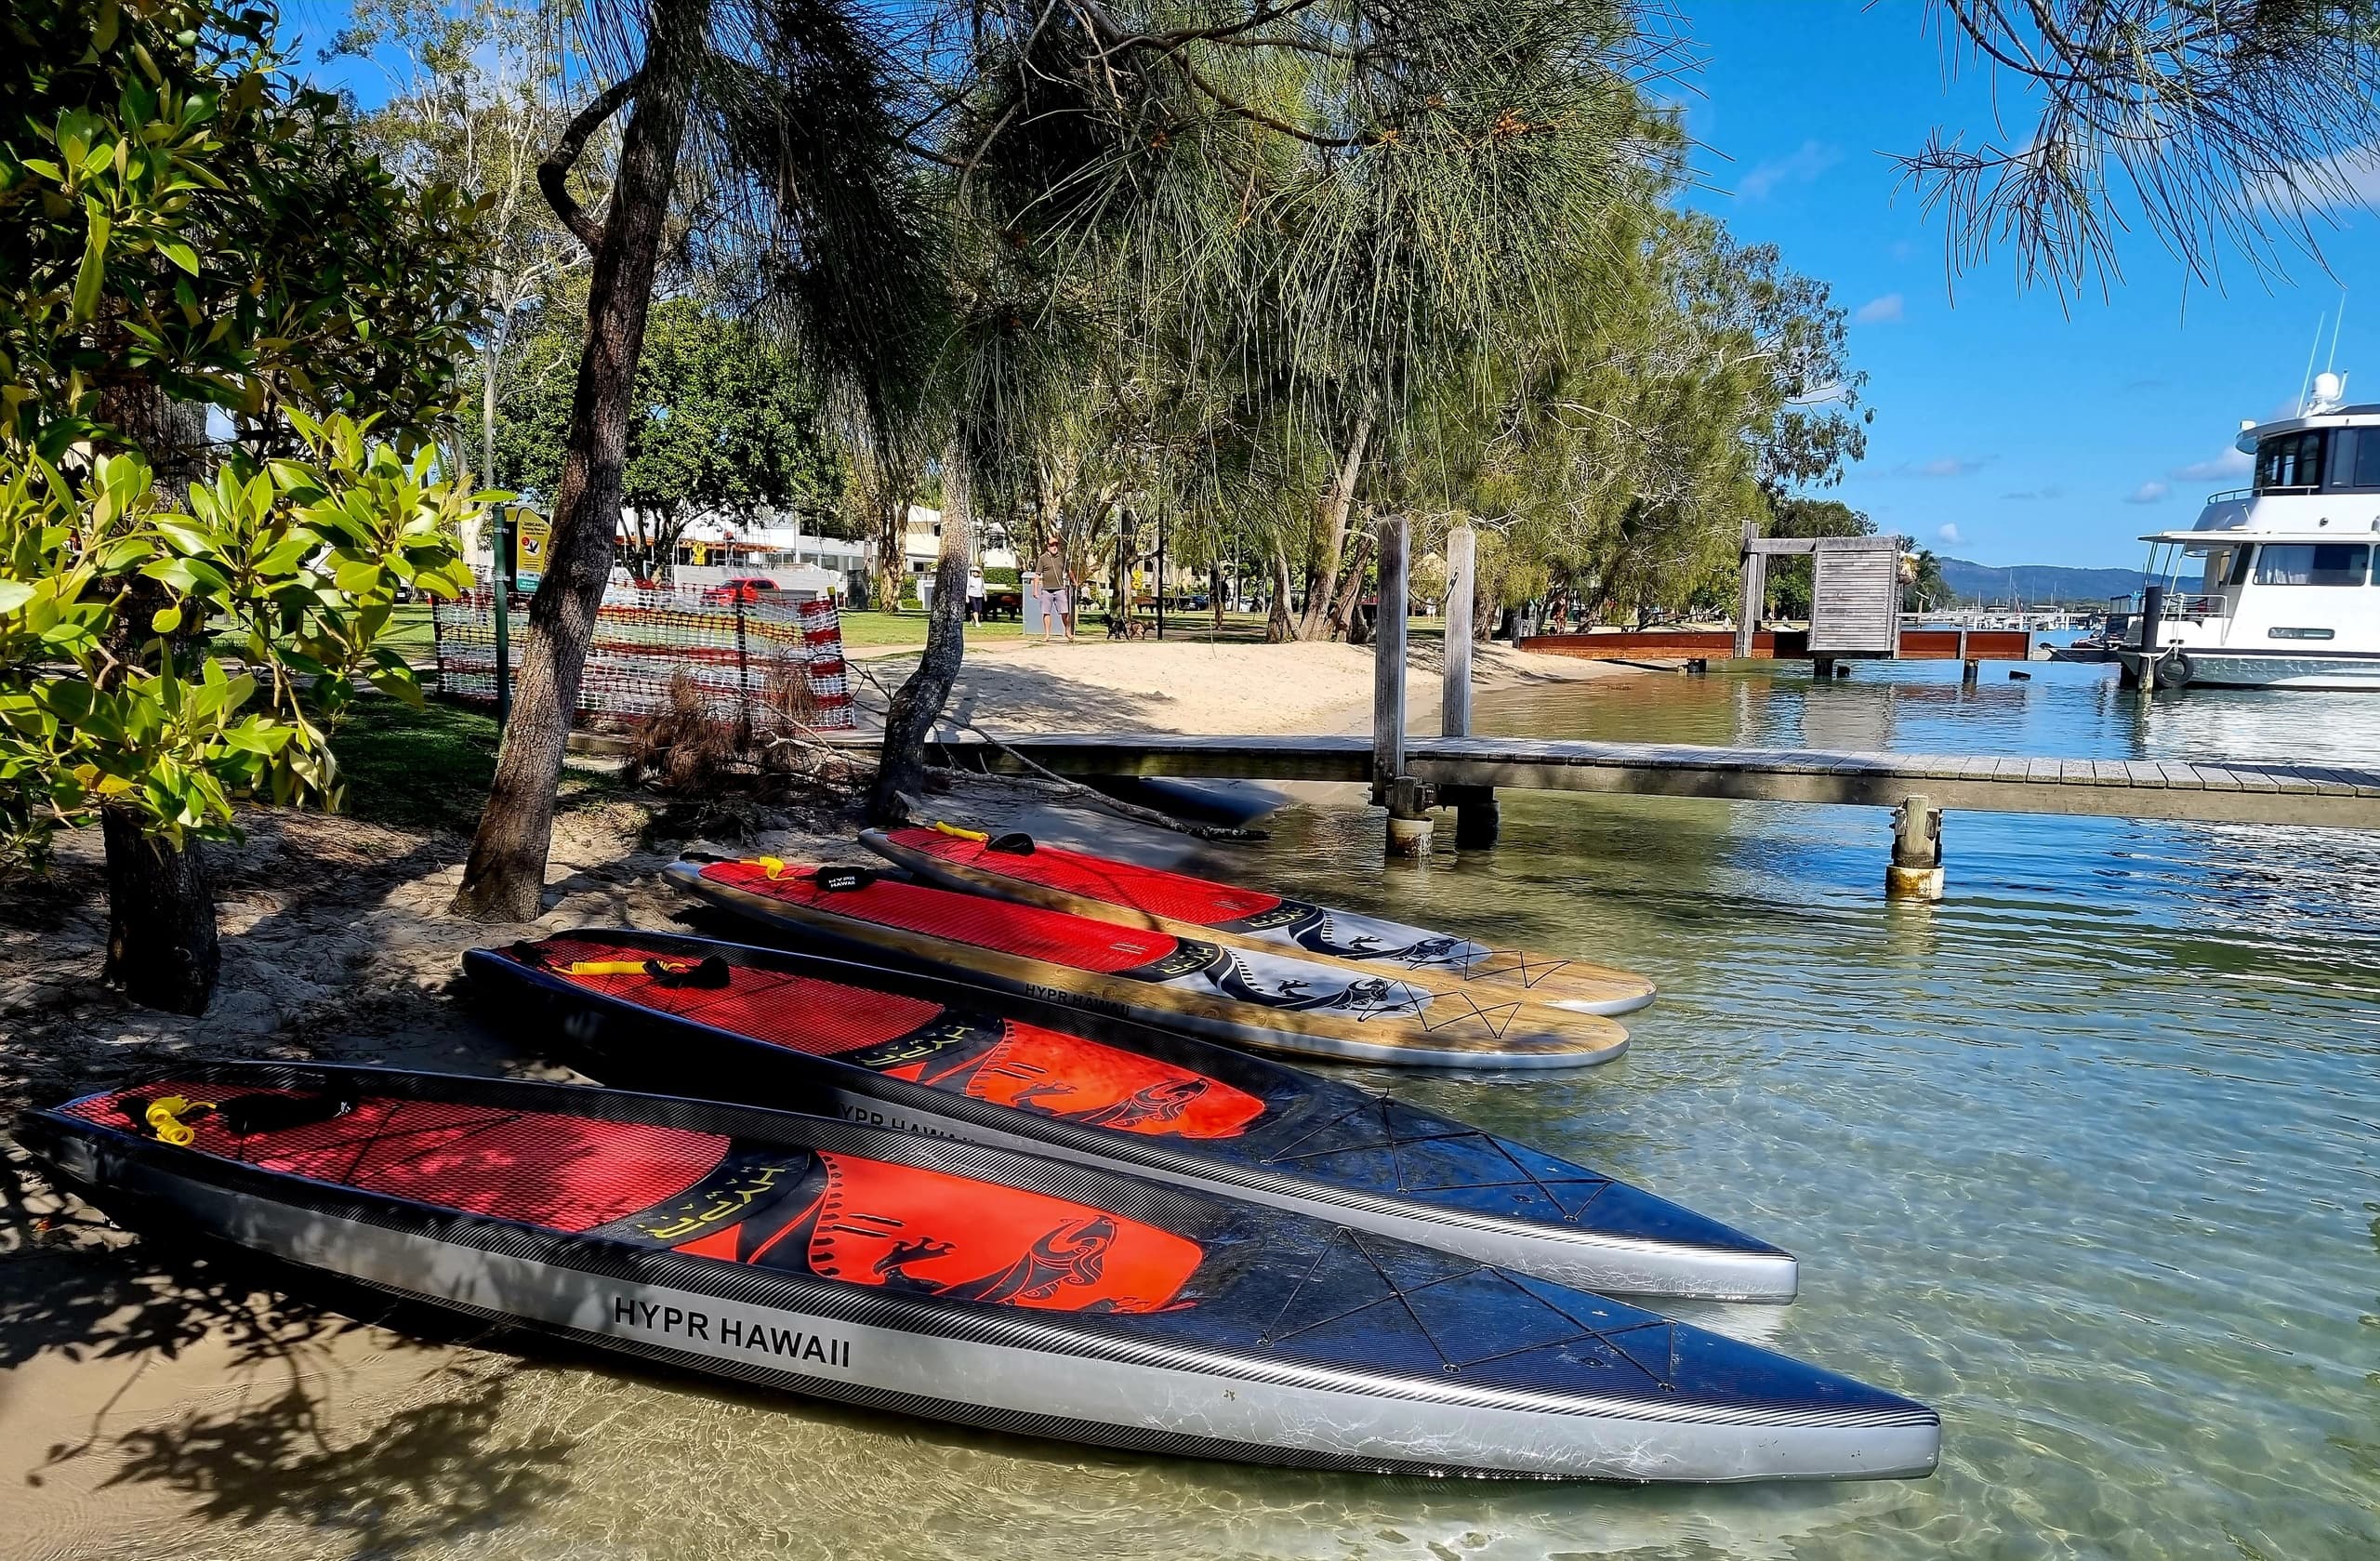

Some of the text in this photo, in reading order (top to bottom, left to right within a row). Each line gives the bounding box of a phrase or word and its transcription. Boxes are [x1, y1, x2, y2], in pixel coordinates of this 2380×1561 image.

[1158, 946, 1214, 974] HYPR
[1025, 983, 1067, 1004] HYPR
[859, 1025, 975, 1066] HYPR
[837, 1103, 884, 1125] YPR
[643, 1167, 787, 1239] HYPR
[615, 1296, 850, 1368] HYPR HAWAII
